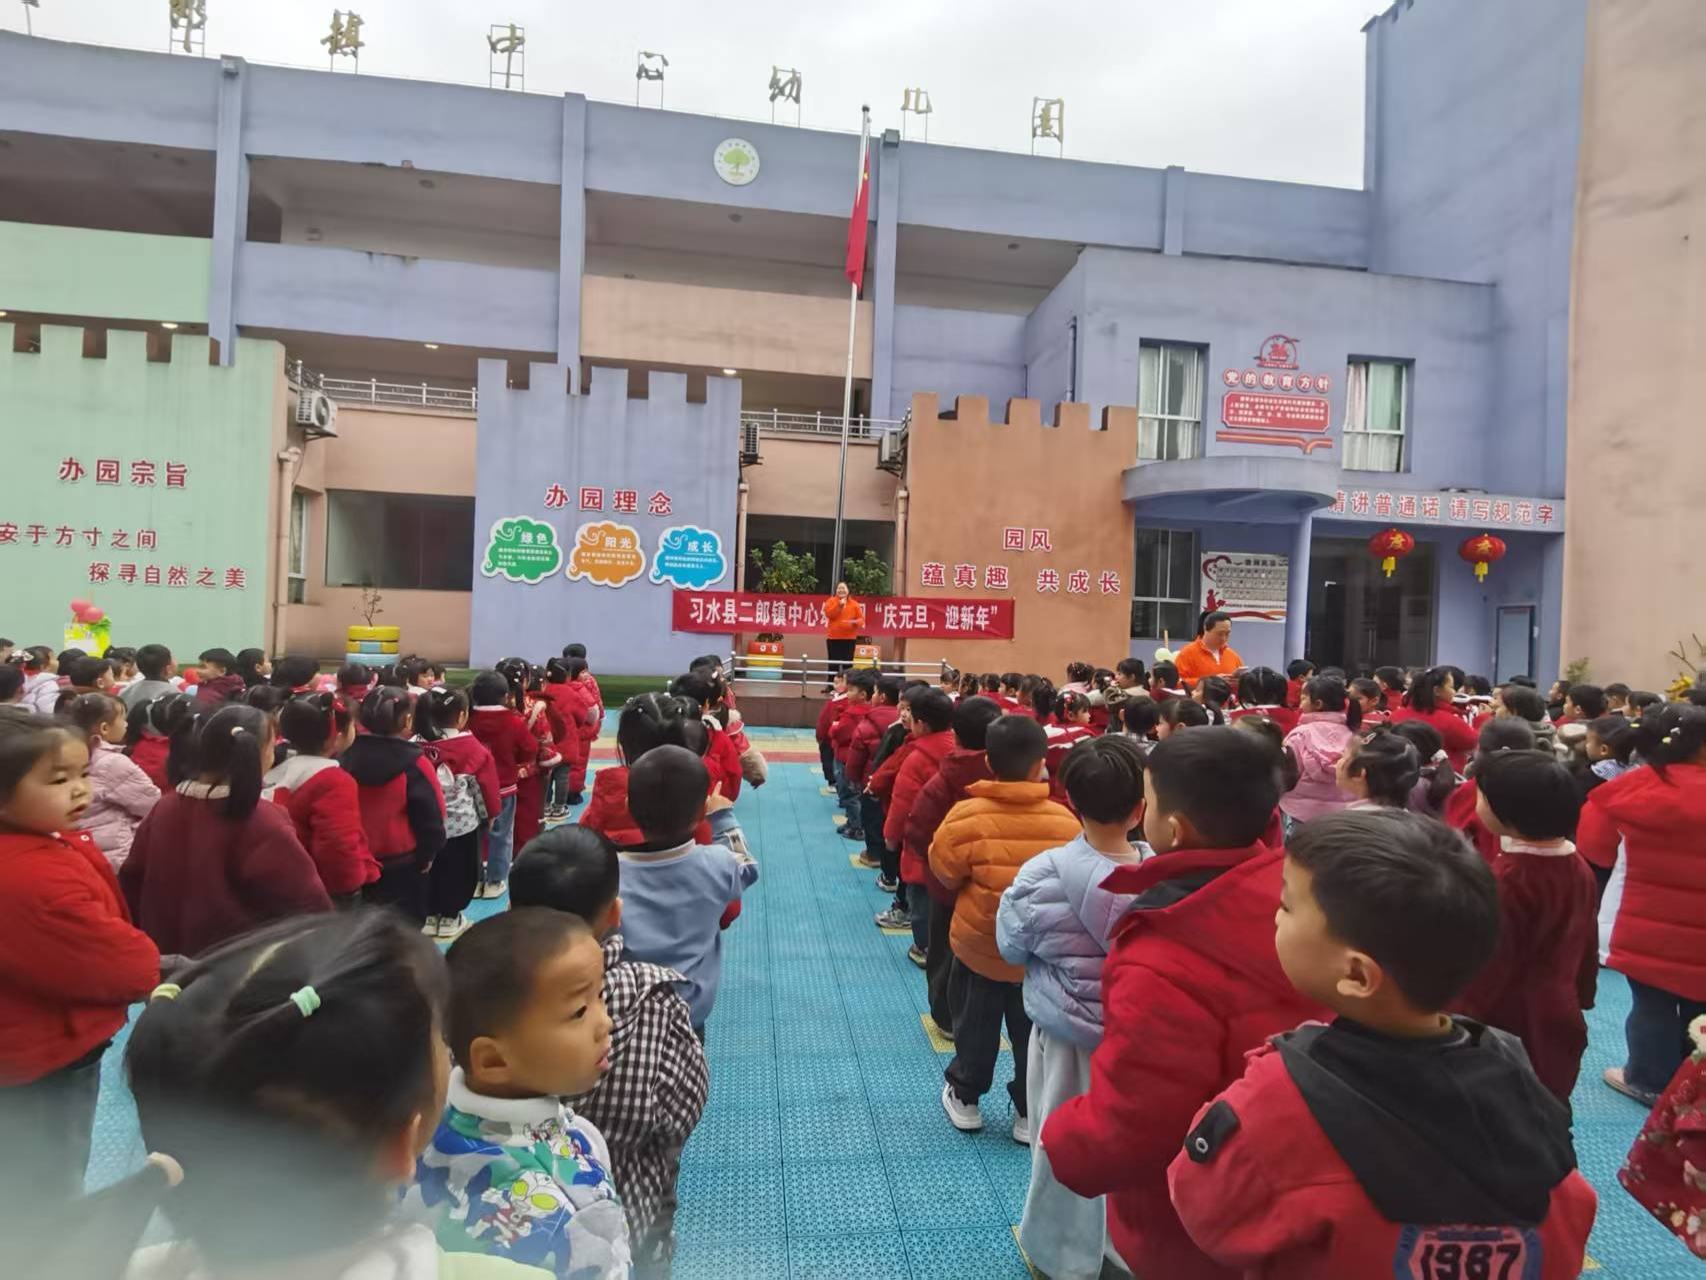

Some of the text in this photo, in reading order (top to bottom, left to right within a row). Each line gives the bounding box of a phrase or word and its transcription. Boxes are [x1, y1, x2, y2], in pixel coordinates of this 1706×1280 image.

[1225, 371, 1329, 391] 党的教育方针
[58, 457, 188, 487] 办园宗旨
[545, 484, 673, 515] 办园理念
[1450, 497, 1554, 524] 请写规范字
[0, 523, 157, 550] 安于方寸之间
[604, 536, 632, 549] 阳光
[687, 540, 713, 553] 成长
[1004, 528, 1051, 551] 园风
[88, 562, 246, 588] 探寻自然之美
[922, 563, 1120, 593] 蕴真趣 共成长
[689, 597, 865, 629] 习水县二郎镇中心
